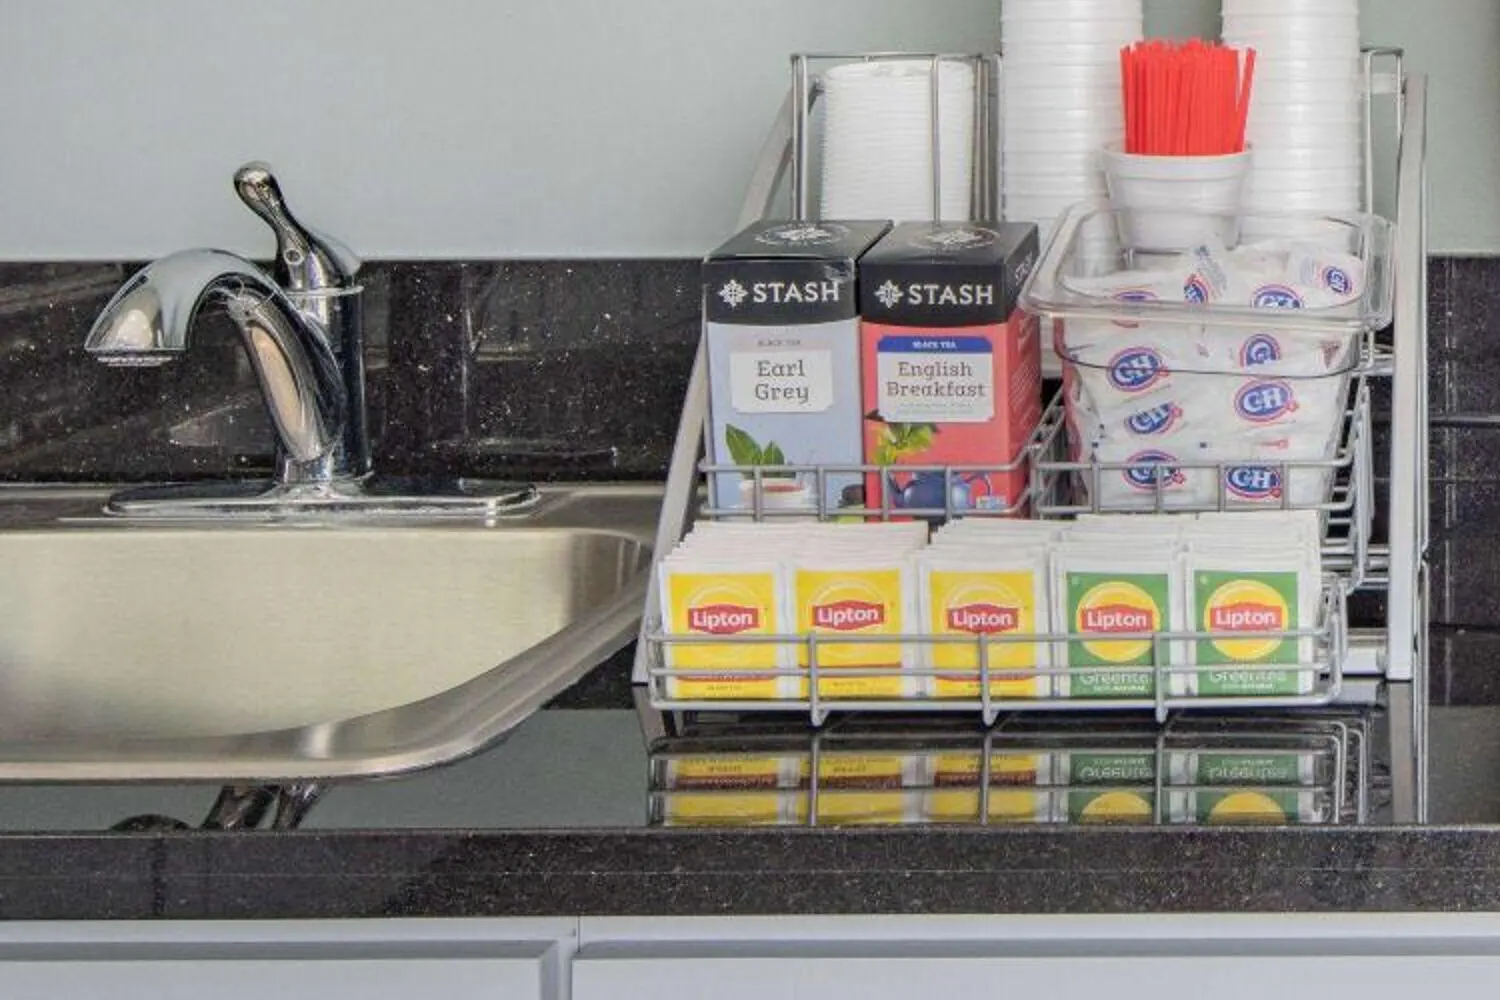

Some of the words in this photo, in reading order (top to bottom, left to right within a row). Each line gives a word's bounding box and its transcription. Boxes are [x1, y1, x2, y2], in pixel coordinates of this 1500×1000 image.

[752, 281, 840, 303] STASH
[907, 284, 994, 305] STASH
[757, 360, 806, 377] Earl
[898, 361, 973, 381] English
[755, 383, 809, 404] Grey
[886, 381, 986, 397] Breakfast
[692, 611, 753, 630] Lipton
[818, 607, 879, 626] Lipton
[952, 610, 1013, 628] Lipton
[1087, 611, 1147, 630] Lipton
[1215, 609, 1276, 628] Lipton
